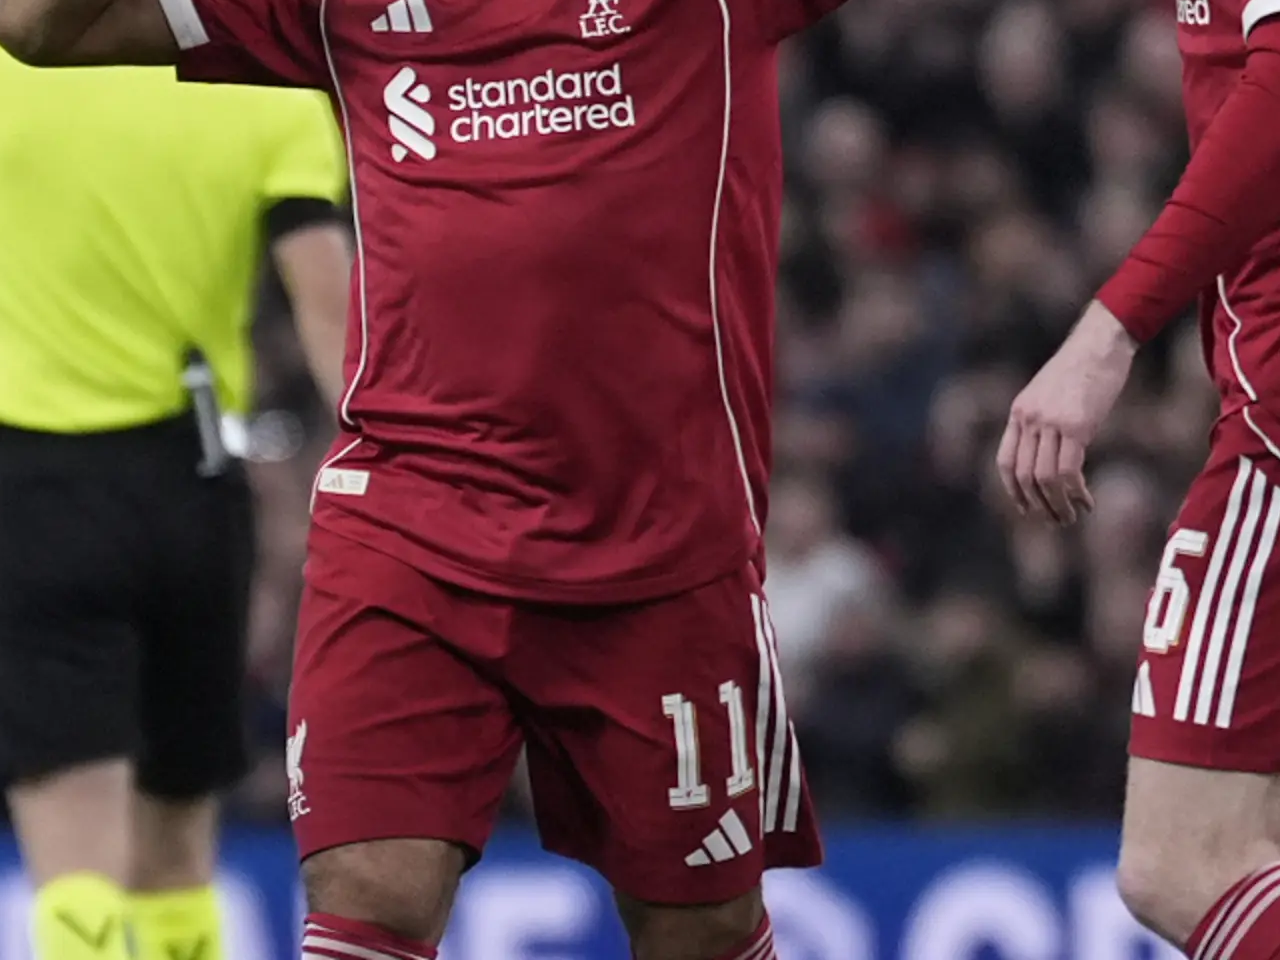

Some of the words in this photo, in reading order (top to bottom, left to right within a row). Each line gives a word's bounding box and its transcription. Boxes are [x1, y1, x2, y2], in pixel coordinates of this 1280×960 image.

[447, 63, 622, 111] standard
[449, 95, 636, 142] chartered
[661, 680, 754, 810] 11
